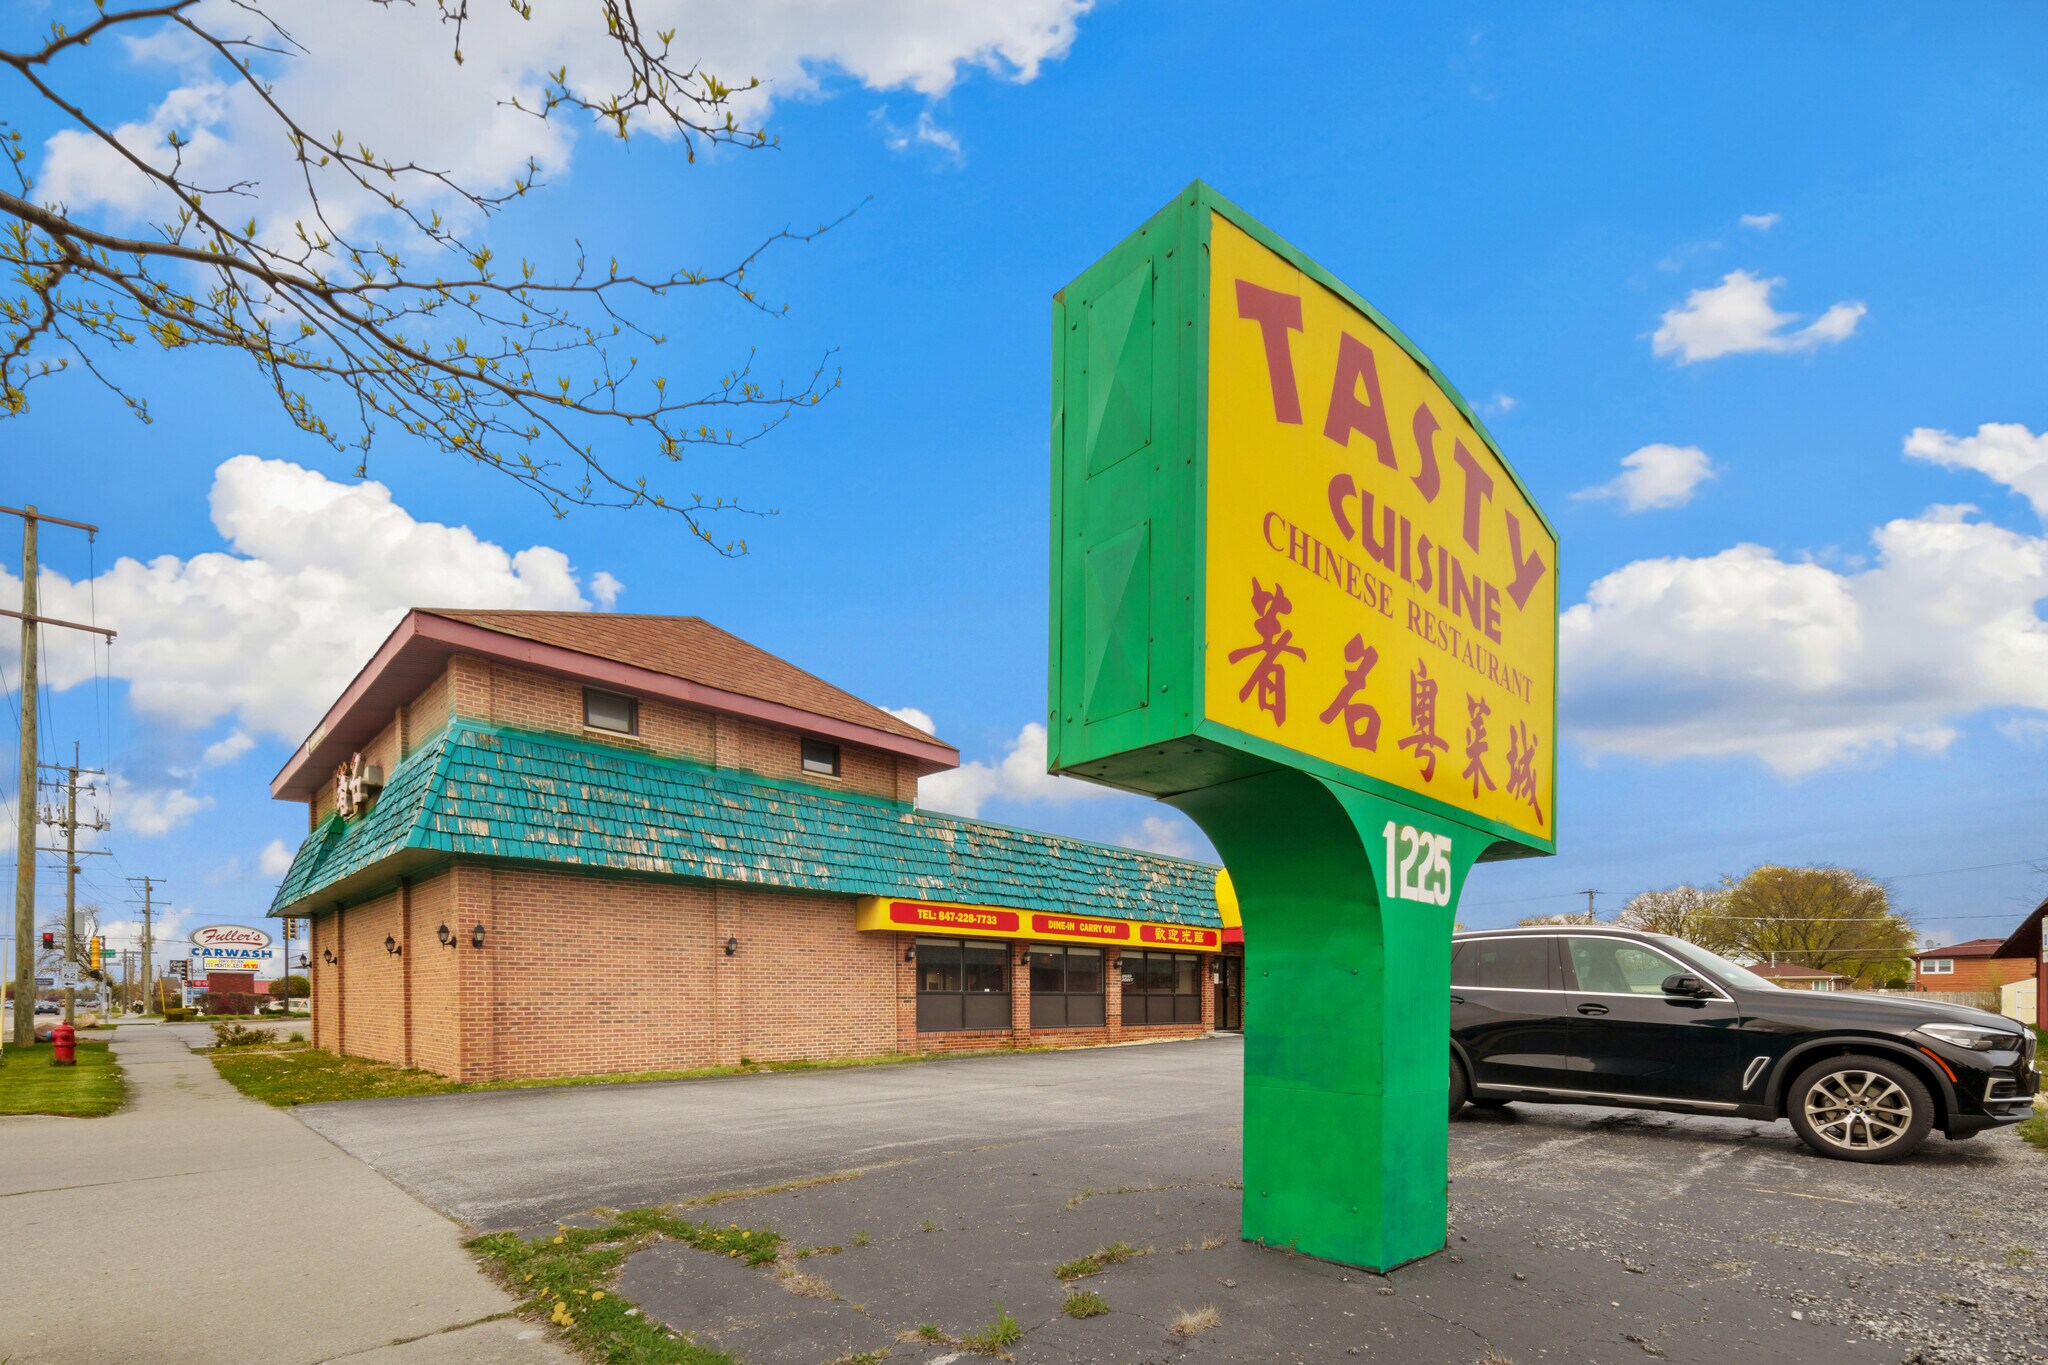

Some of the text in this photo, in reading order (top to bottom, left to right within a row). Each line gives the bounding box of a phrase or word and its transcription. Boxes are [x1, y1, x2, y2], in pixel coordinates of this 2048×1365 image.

[1234, 278, 1546, 612] TASTY
[1327, 473, 1502, 645] CUISINE
[1263, 511, 1533, 704] CHINESE RESTAURANT
[1382, 820, 1452, 907] 1225
[202, 929, 262, 943] Fuller's
[917, 908, 998, 925] TEL: 847-228-7733
[1048, 920, 1117, 934] DINE-IN CARRY OUT
[191, 947, 273, 958] CARWASH
